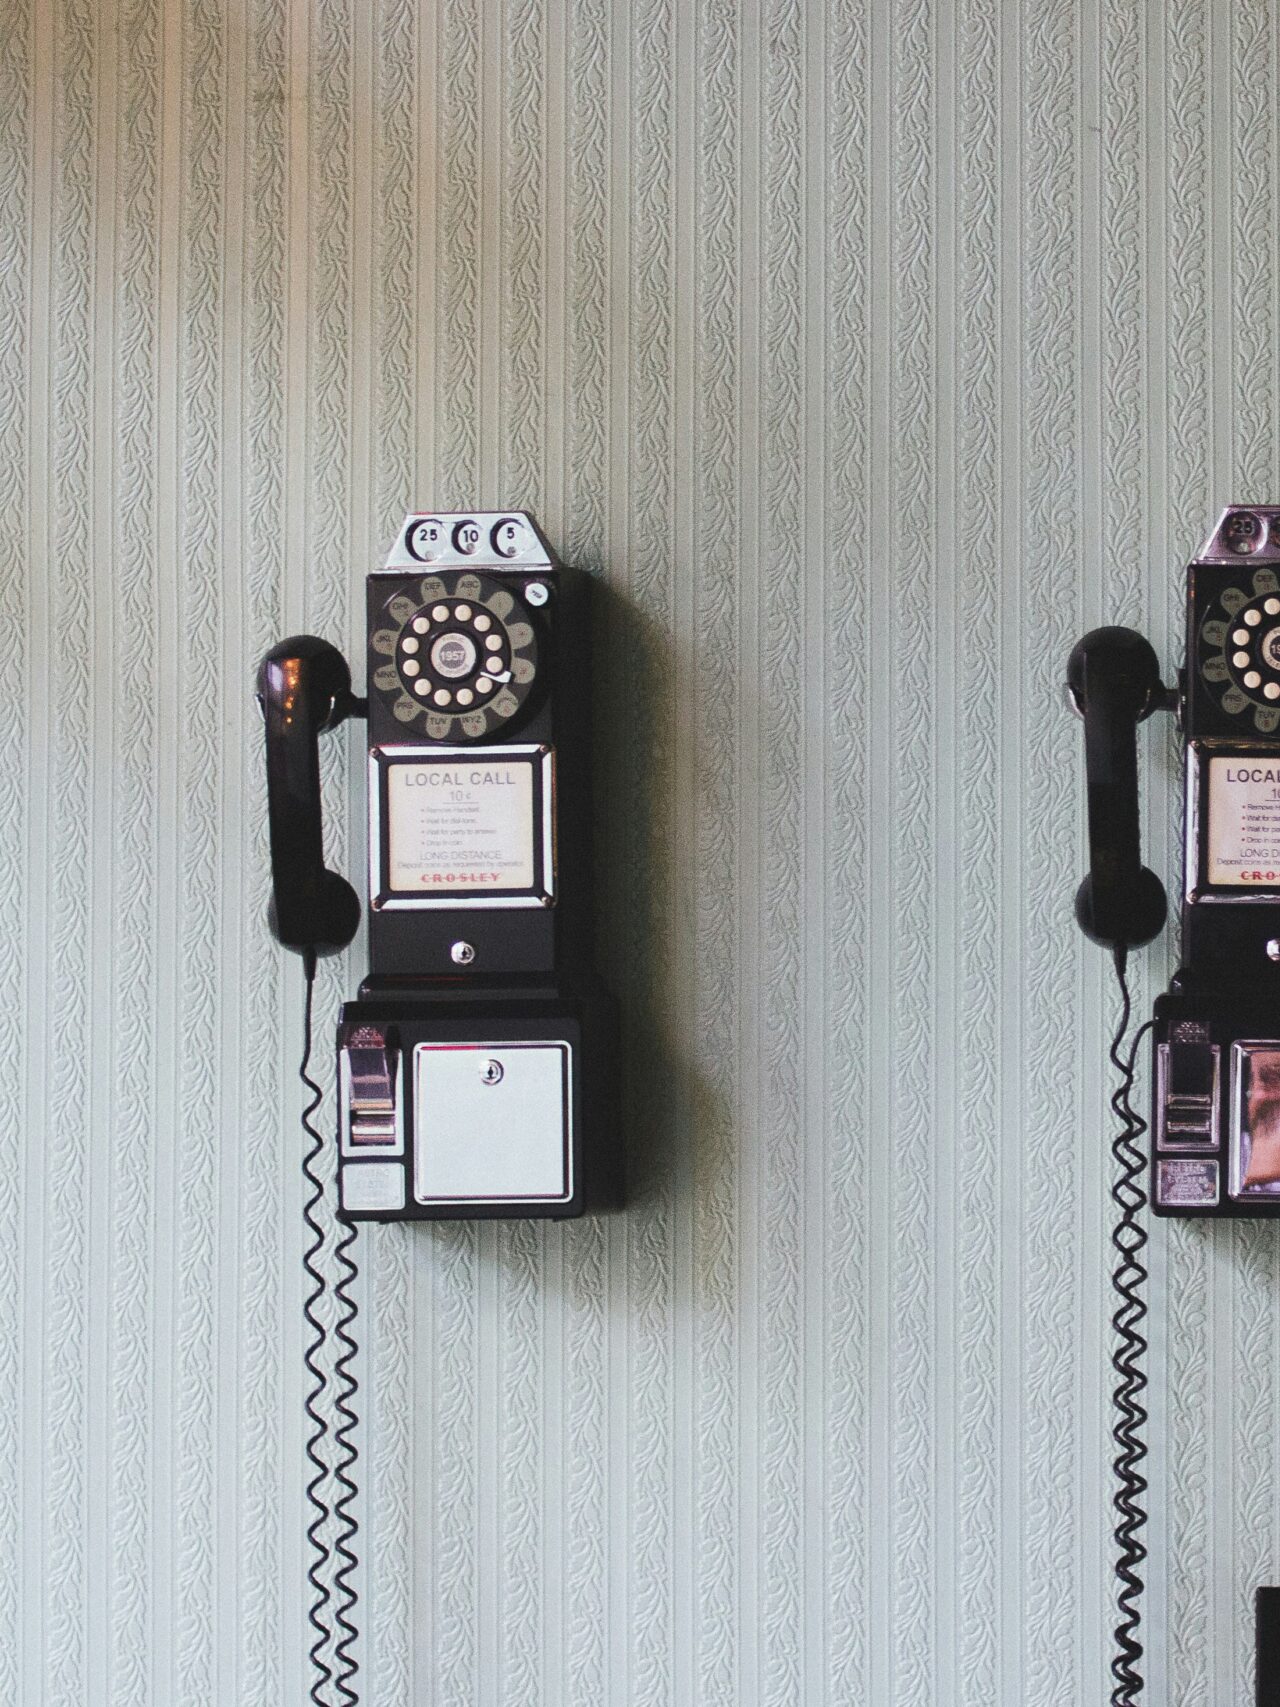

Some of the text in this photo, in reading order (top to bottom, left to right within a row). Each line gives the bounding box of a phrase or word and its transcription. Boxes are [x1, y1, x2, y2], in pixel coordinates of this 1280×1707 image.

[420, 527, 515, 543] 25 10 5
[460, 580, 479, 588] ABC
[441, 651, 465, 661] 1957
[405, 771, 516, 786] LOCAL CALL
[420, 850, 502, 861] LONG DISTANCE
[1240, 848, 1269, 858] LONG
[421, 872, 500, 882] CROSLEY
